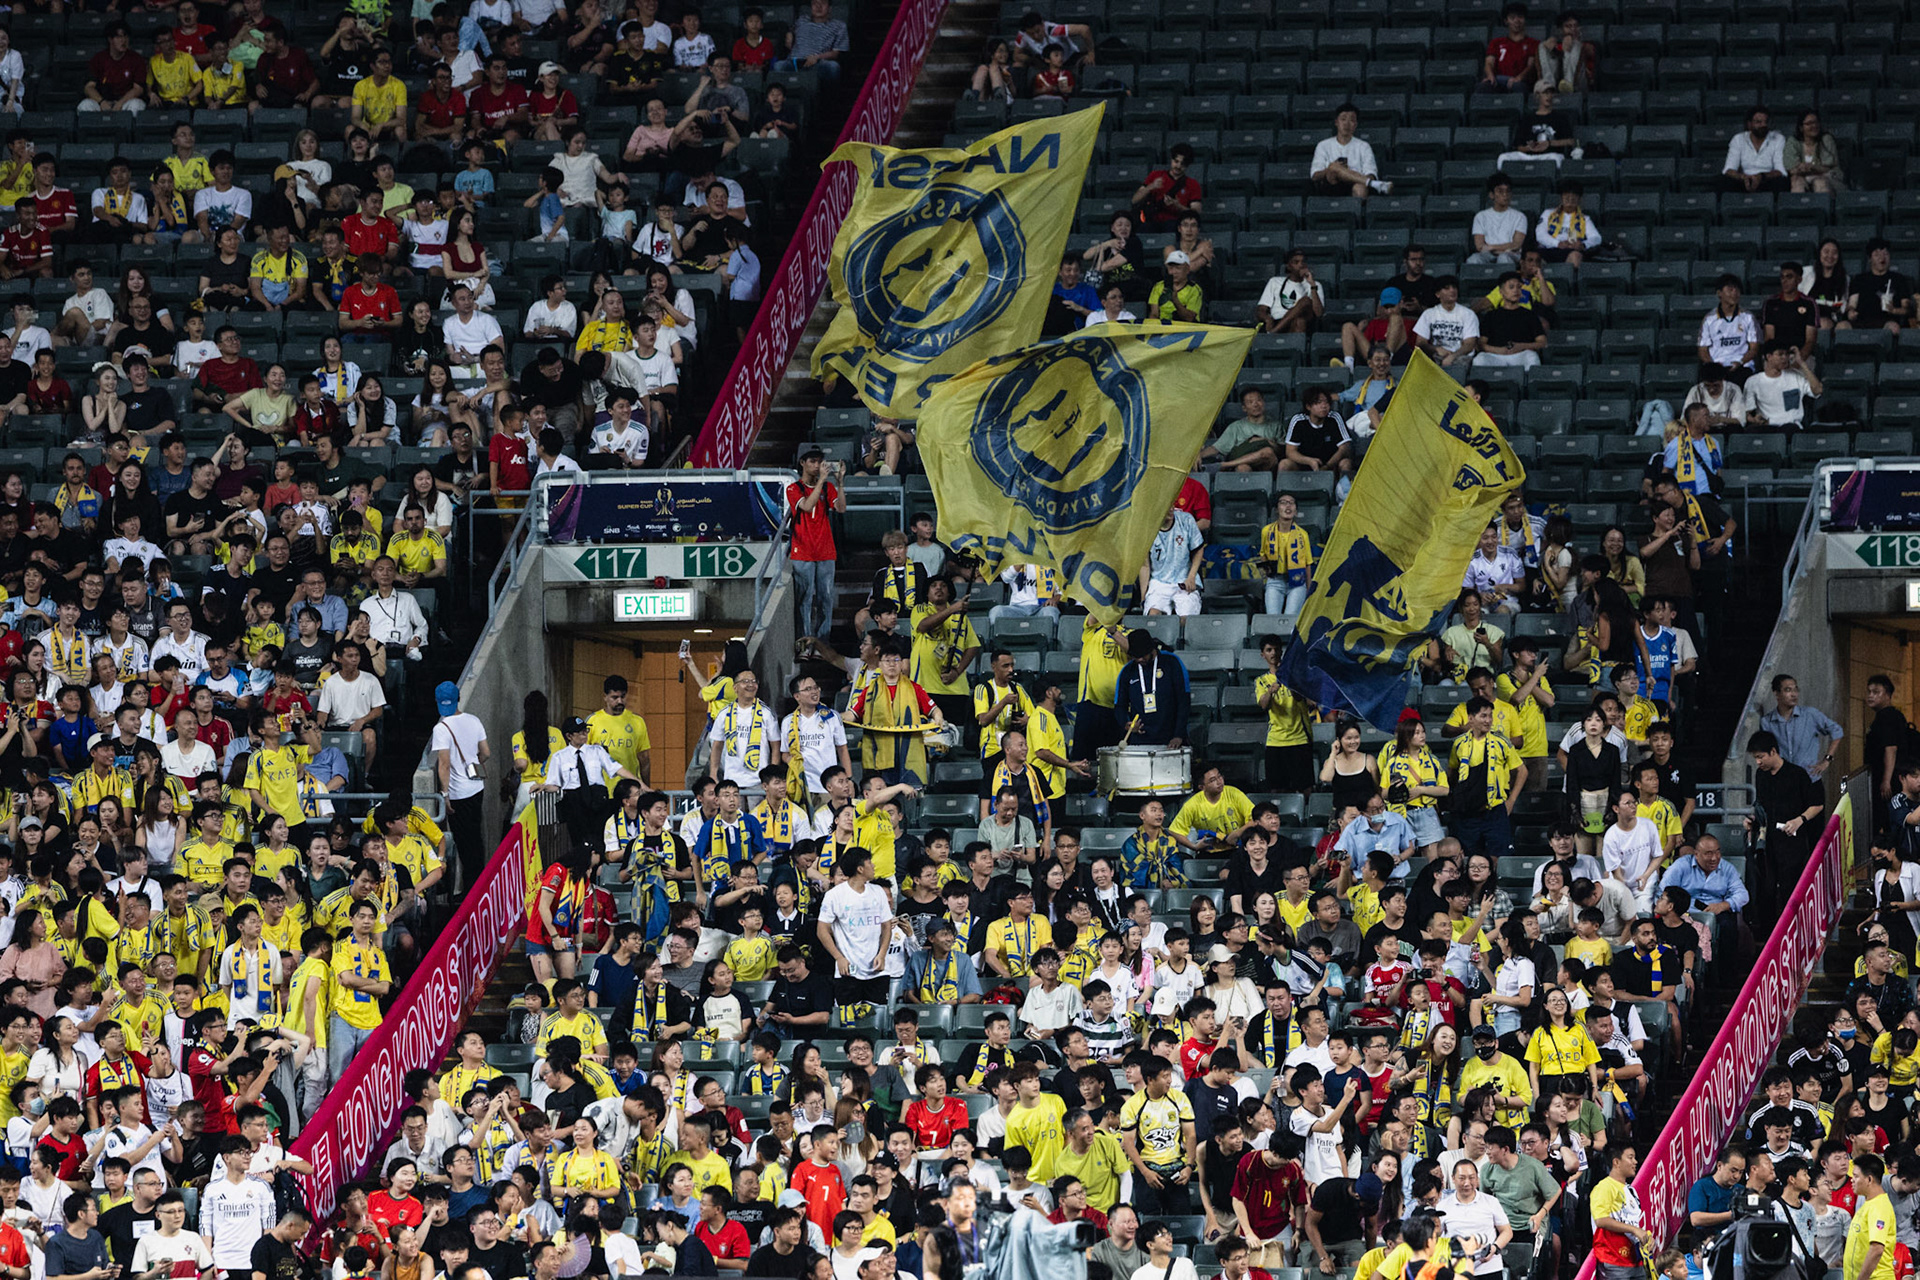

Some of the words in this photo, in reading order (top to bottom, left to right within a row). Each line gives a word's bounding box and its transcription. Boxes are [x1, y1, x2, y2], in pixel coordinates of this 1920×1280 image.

[689, 546, 744, 577] 118
[1869, 536, 1920, 566] 118
[588, 549, 642, 578] 117
[624, 596, 660, 615] EXIT
[848, 915, 881, 927] KAFD
[337, 1048, 395, 1185] HONG
[391, 966, 448, 1110] KONG
[447, 839, 526, 1023] STADIUM
[1689, 1041, 1737, 1183] HONG
[1733, 957, 1780, 1107] KONG
[1779, 828, 1843, 1017] STADIUM
[929, 1131, 938, 1145] 7
[821, 1185, 830, 1201] 7
[218, 1202, 255, 1211] Emirates
